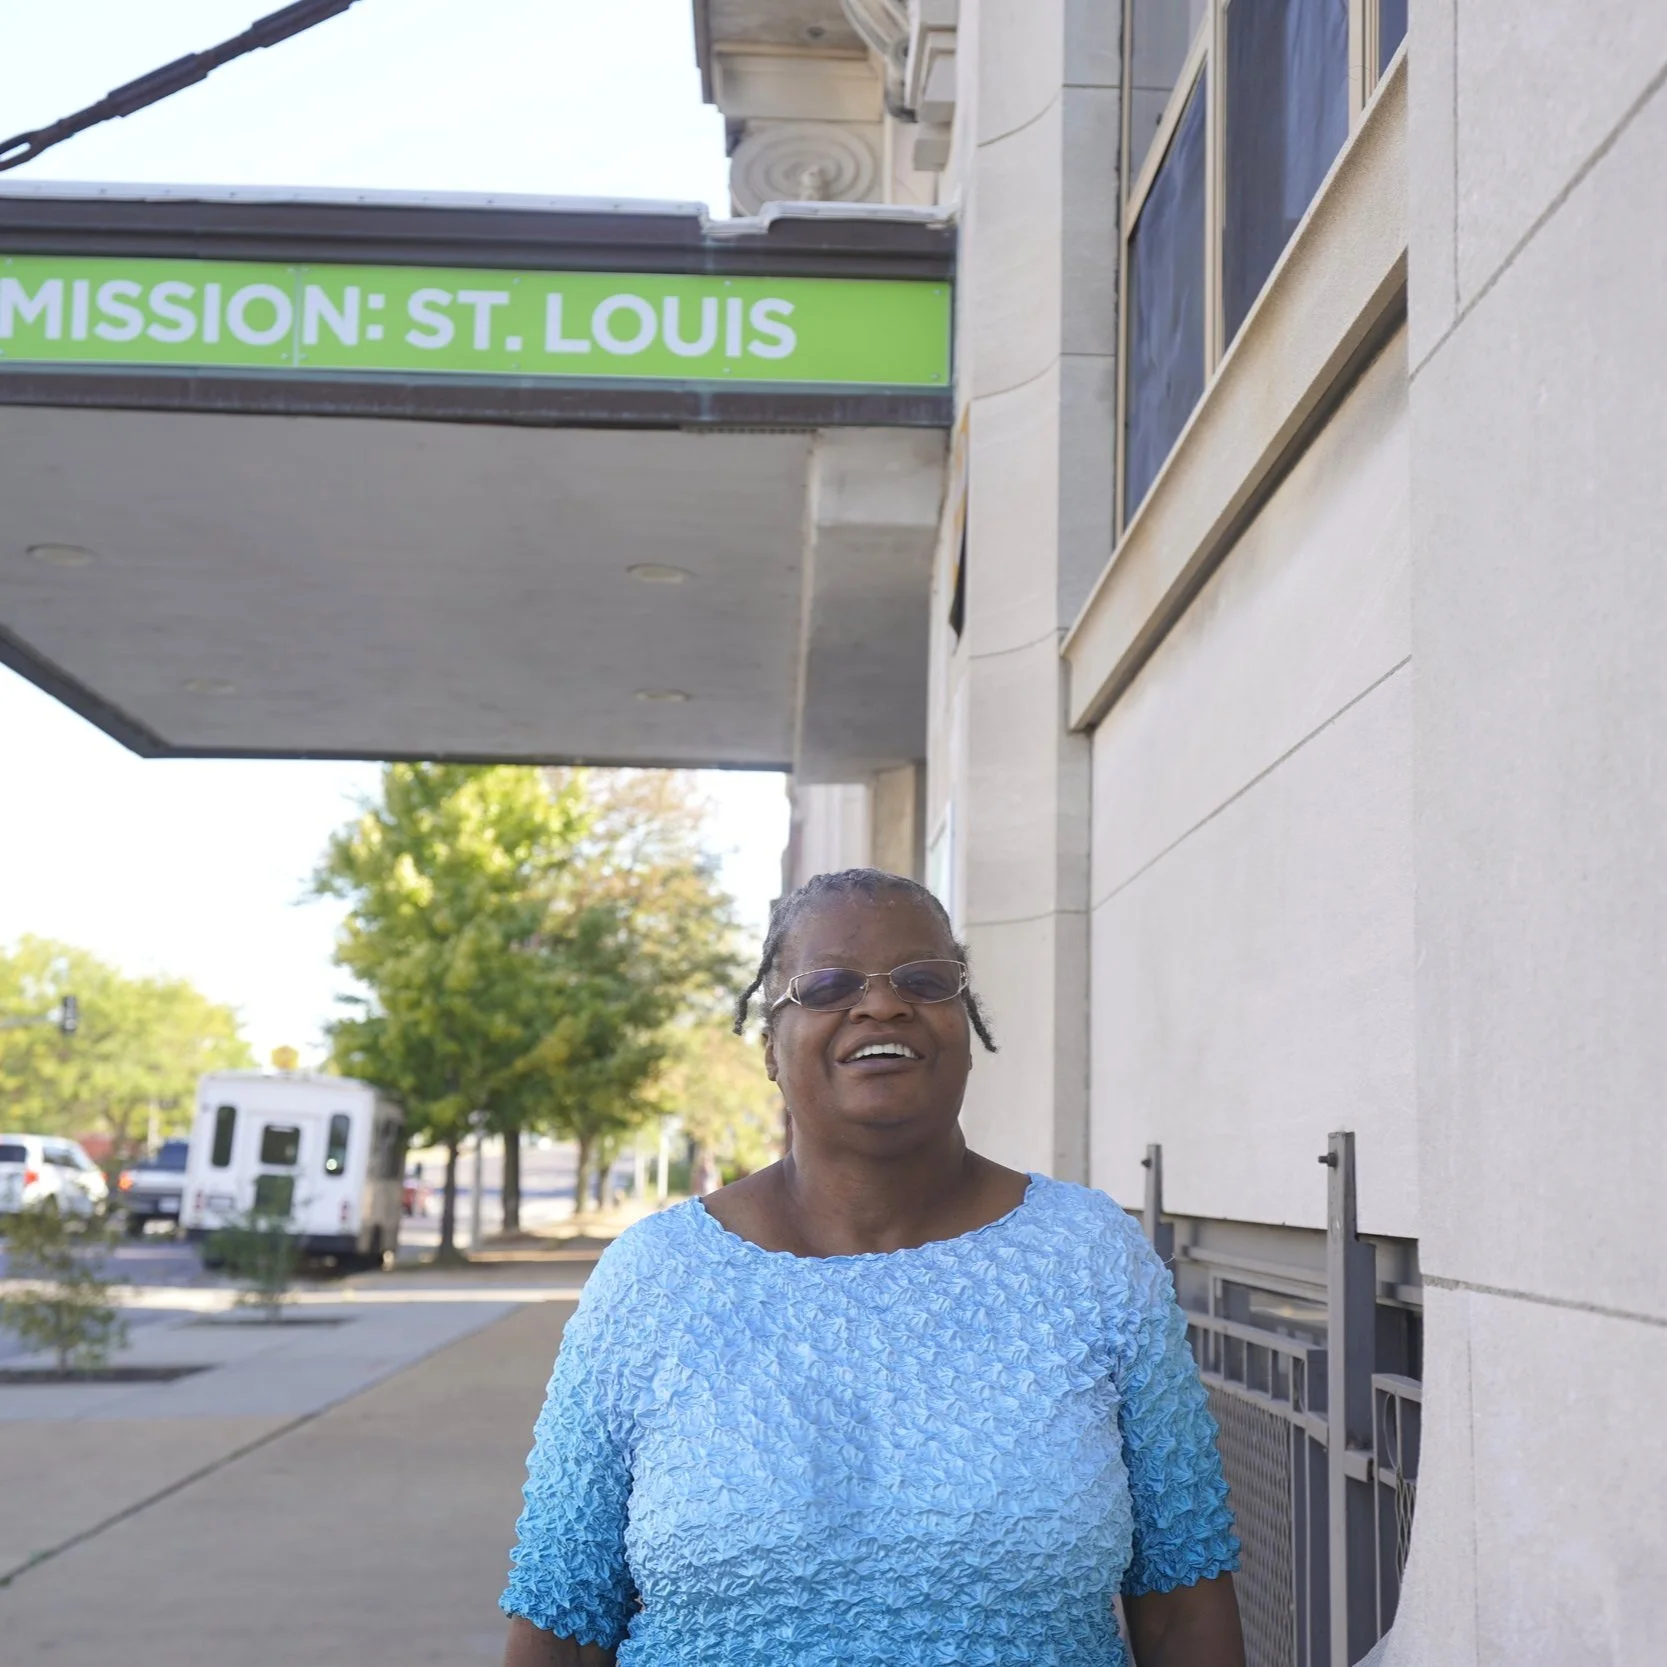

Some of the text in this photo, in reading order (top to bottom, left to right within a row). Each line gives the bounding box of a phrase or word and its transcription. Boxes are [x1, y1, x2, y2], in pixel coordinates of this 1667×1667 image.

[0, 277, 797, 359] MISSION: ST. LOUIS
